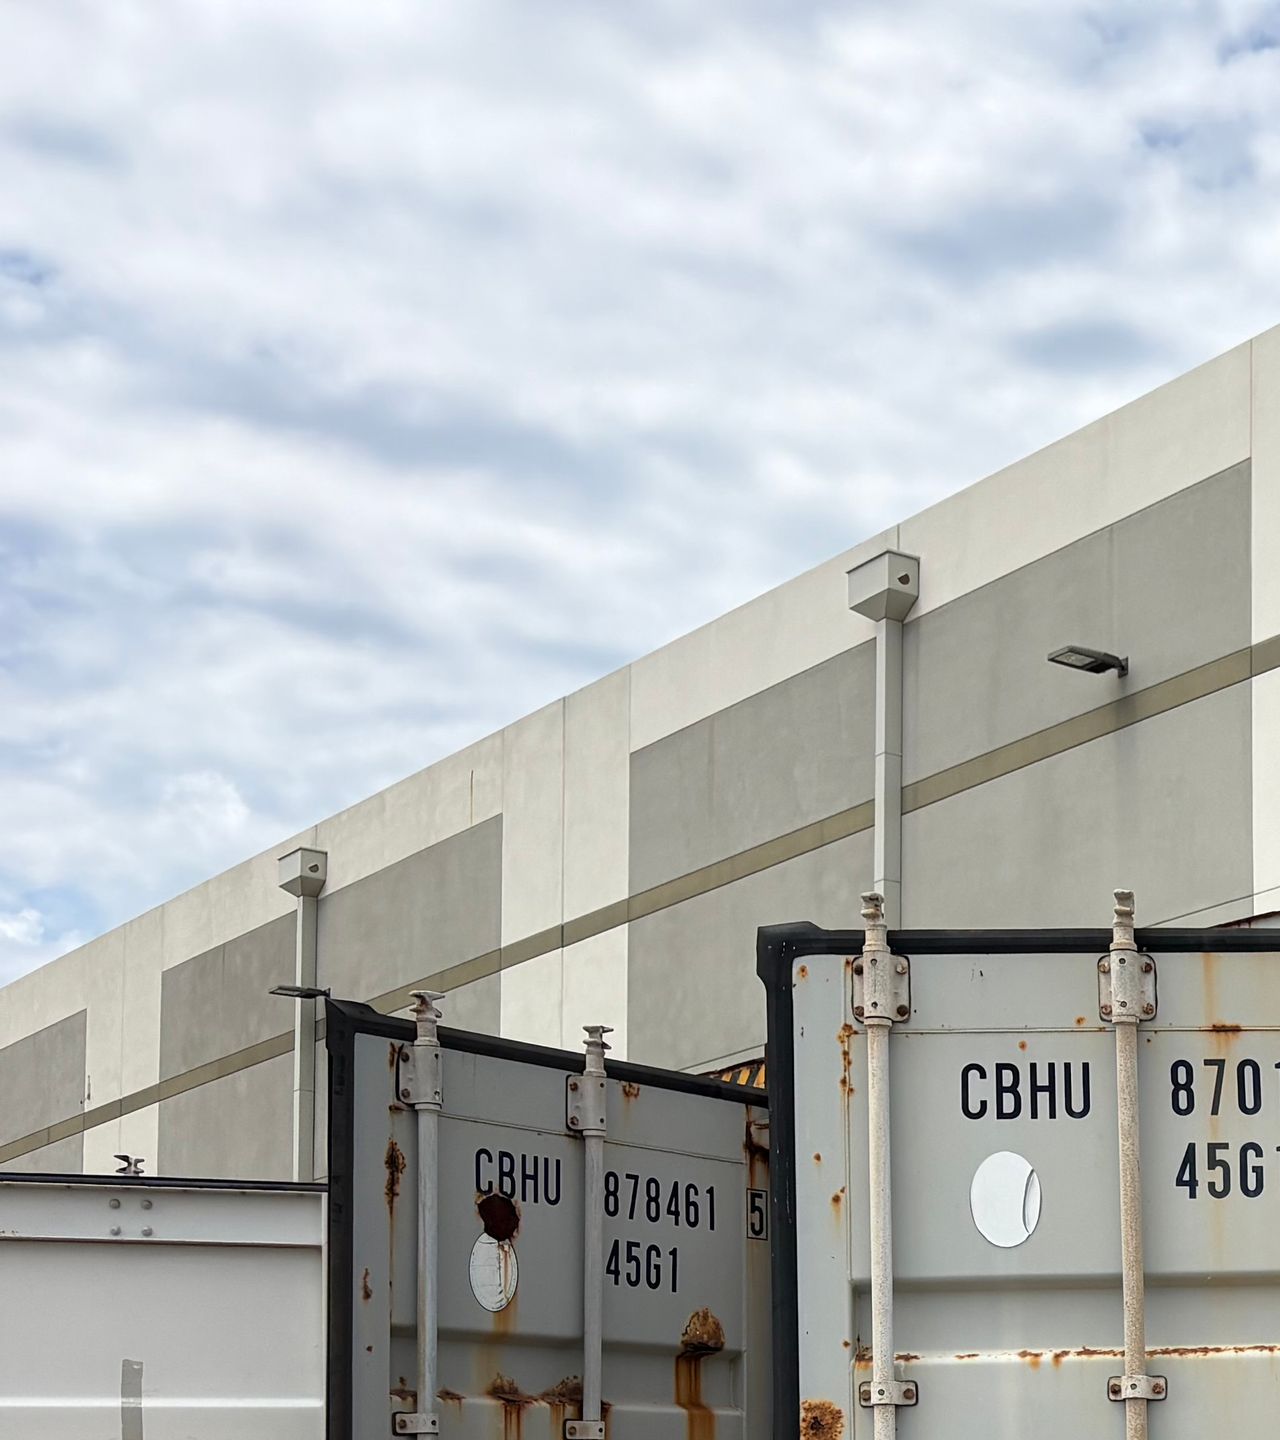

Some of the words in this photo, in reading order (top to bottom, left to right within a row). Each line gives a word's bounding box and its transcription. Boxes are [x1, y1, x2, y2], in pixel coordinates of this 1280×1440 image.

[961, 1061, 1091, 1120] CBHU
[474, 1147, 562, 1206] CBHU
[603, 1170, 716, 1231] 878461
[749, 1191, 765, 1237] 5
[605, 1238, 678, 1293] 45G1
